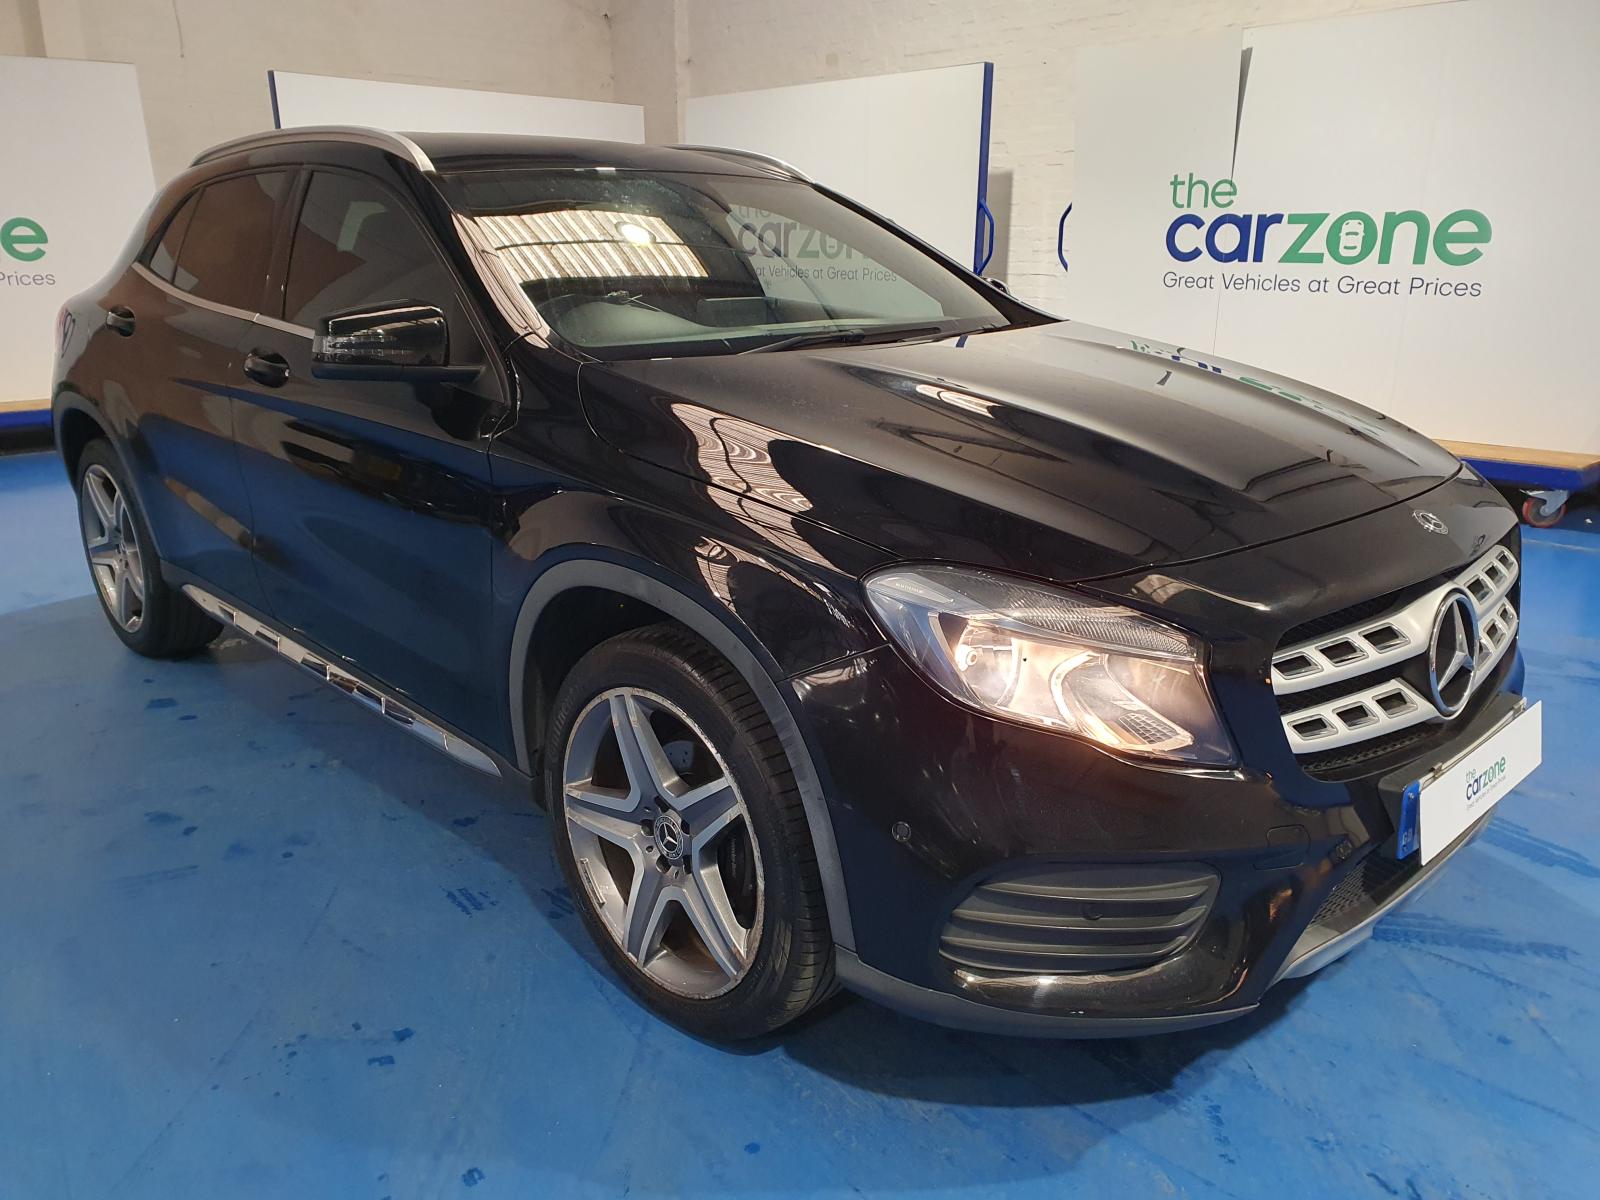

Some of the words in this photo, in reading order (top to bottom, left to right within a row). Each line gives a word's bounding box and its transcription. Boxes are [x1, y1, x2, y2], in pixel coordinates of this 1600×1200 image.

[1170, 172, 1237, 208] the
[1165, 208, 1493, 267] carzone
[813, 267, 823, 279] at
[827, 266, 858, 281] Great
[862, 267, 897, 283] Prices
[1163, 271, 1214, 290] Great
[1221, 273, 1300, 293] Vehicles
[1308, 277, 1329, 293] at
[1337, 275, 1400, 295] Great
[1409, 277, 1482, 297] Prices
[1466, 756, 1506, 800] carzone
